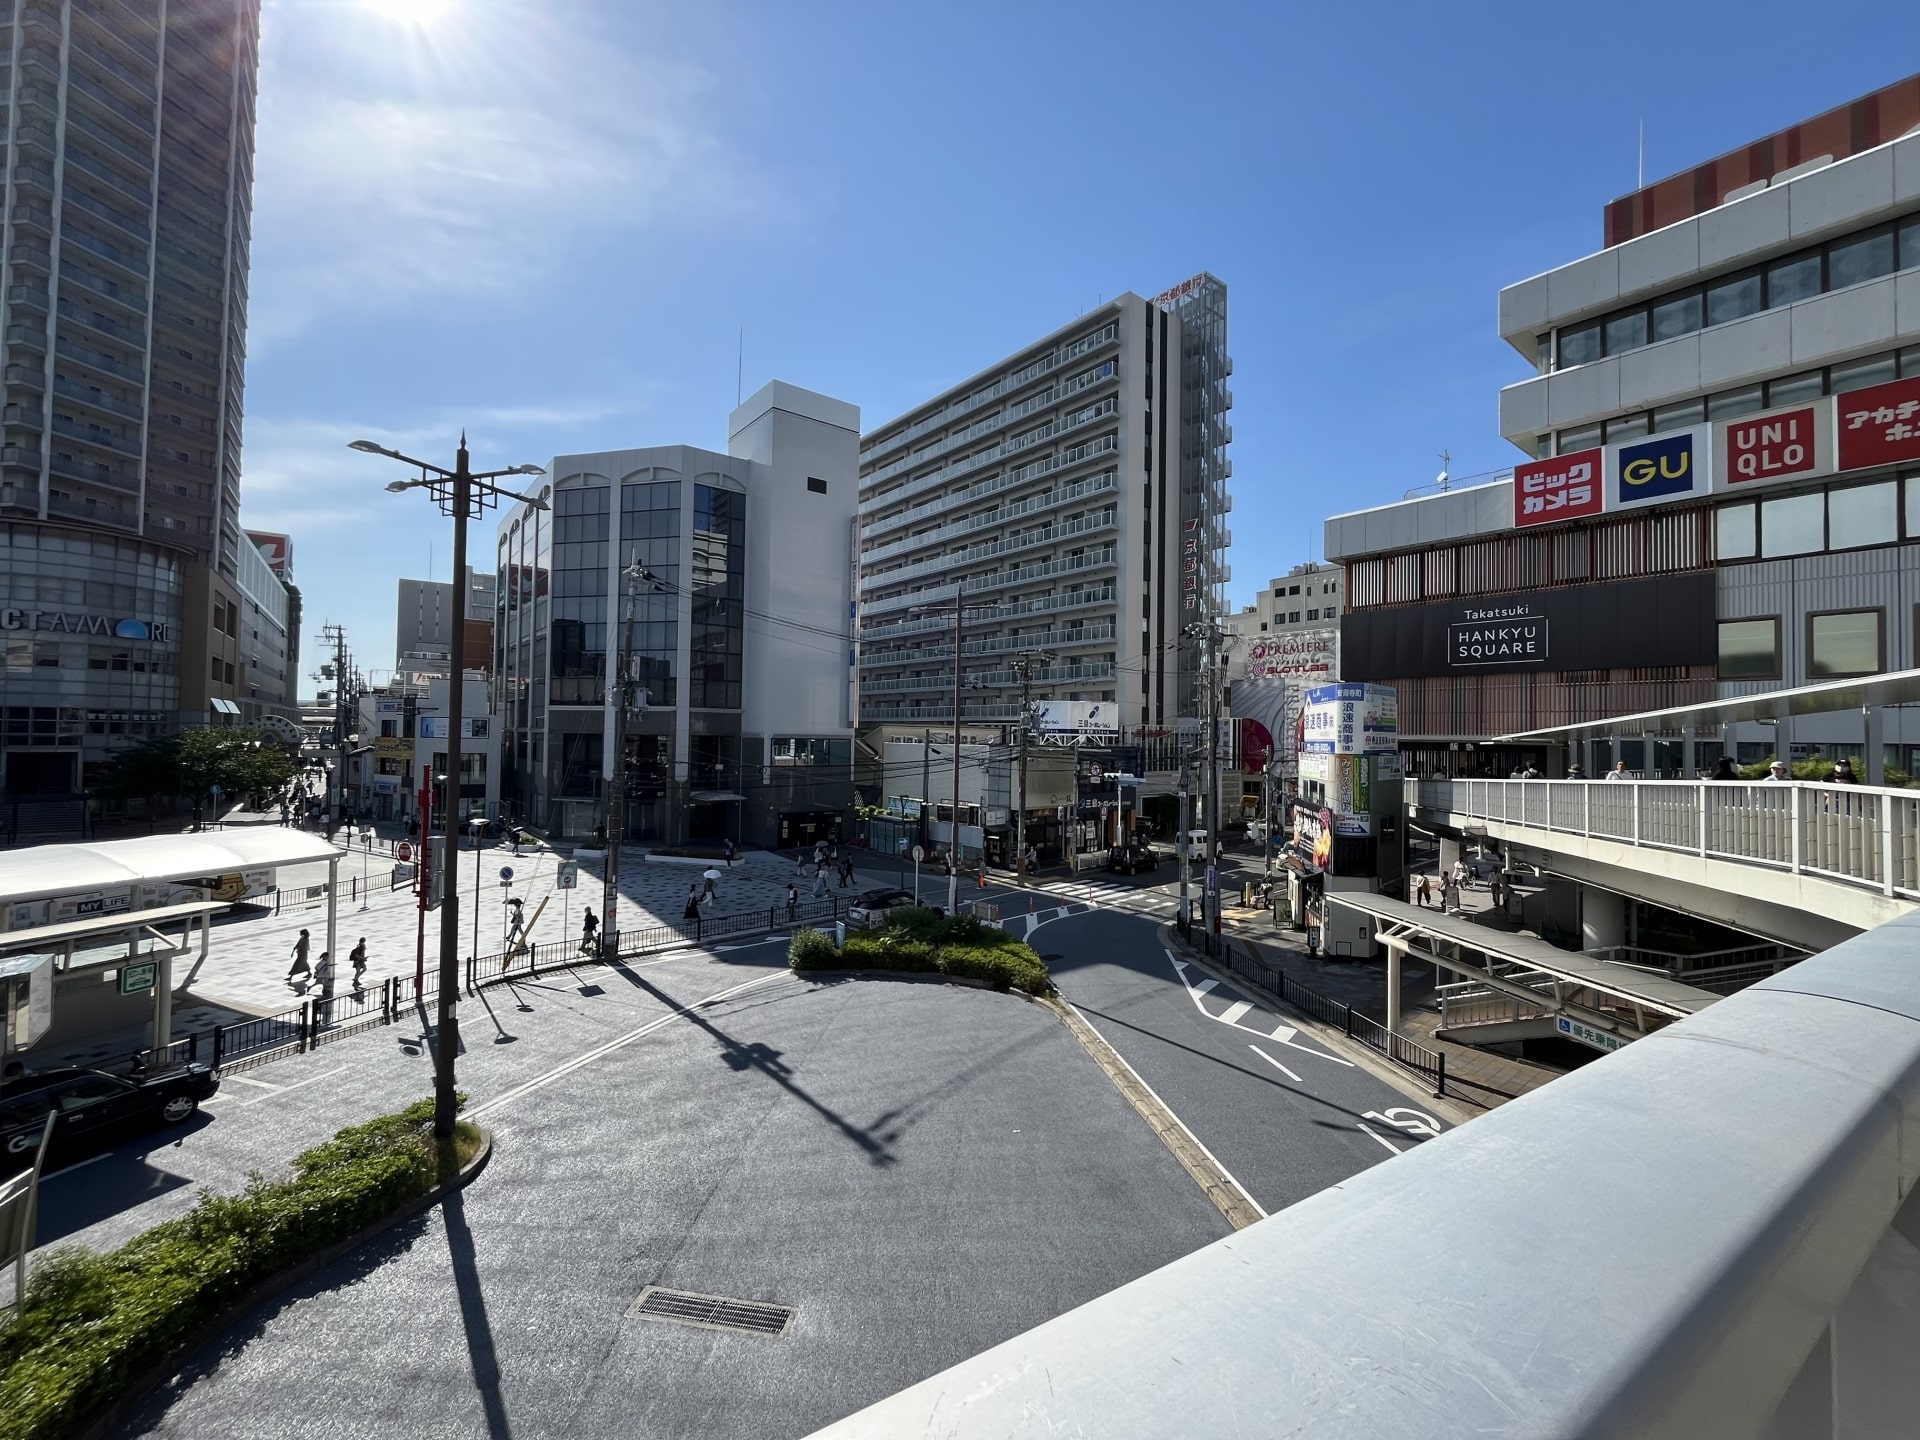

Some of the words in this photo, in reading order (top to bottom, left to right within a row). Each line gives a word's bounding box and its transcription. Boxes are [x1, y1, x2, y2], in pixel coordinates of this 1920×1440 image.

[1736, 419, 1797, 450] UNI
[1623, 451, 1689, 485] GU
[1737, 444, 1804, 476] QLO
[1523, 462, 1592, 493] ビック
[1523, 485, 1592, 515] カメラ
[1464, 604, 1529, 620] Takatsuki
[1268, 641, 1328, 656] PREMIERE
[1459, 626, 1536, 643] HANKYU
[1459, 641, 1536, 658] SQUARE
